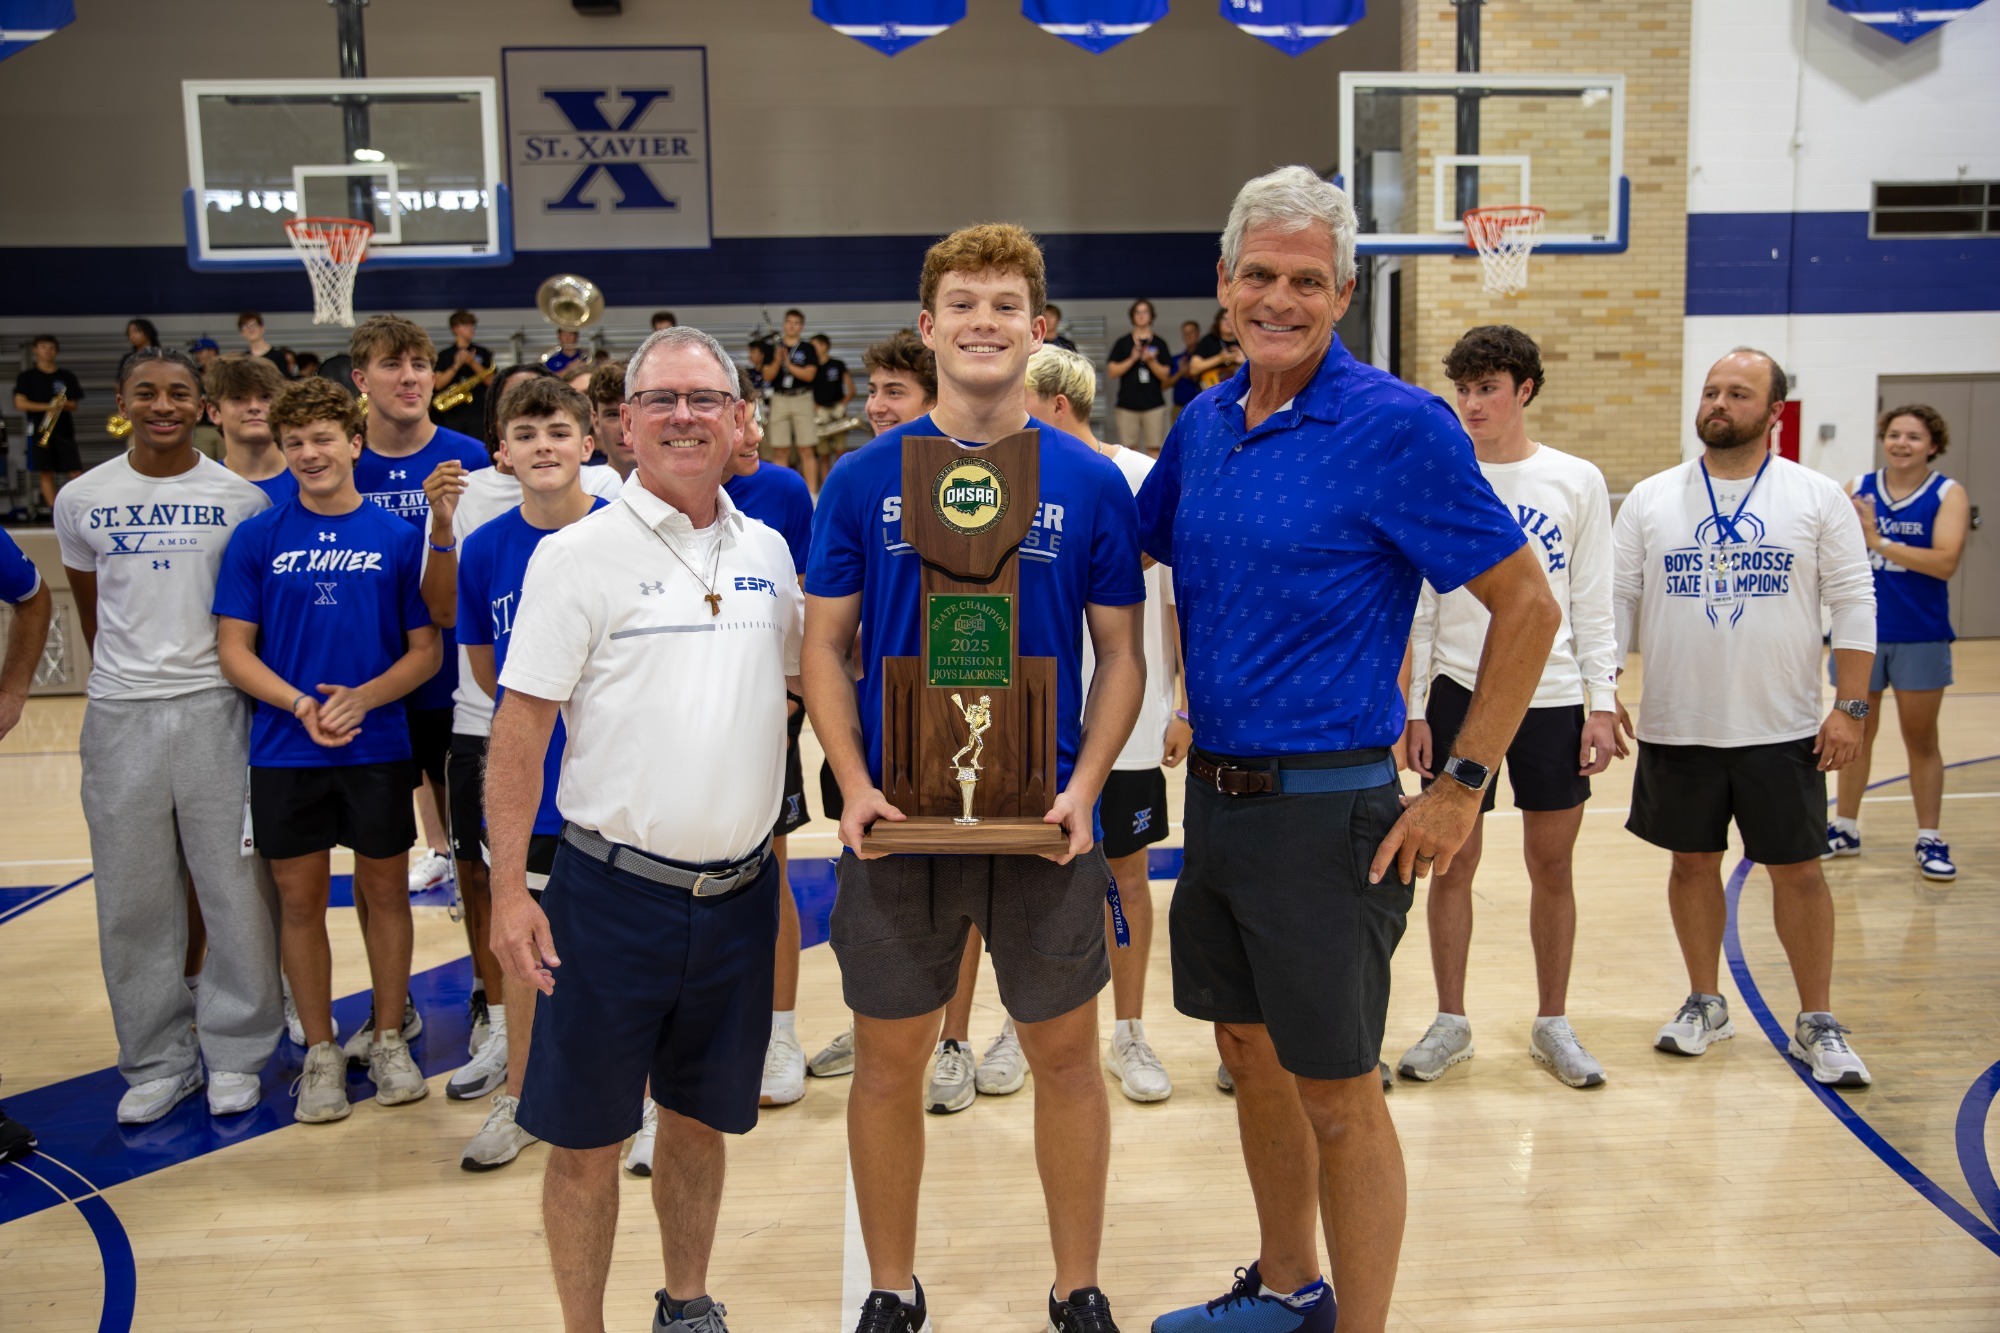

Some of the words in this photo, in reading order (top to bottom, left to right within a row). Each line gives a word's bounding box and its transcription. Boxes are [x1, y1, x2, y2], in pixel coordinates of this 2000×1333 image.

[946, 487, 995, 504] OHSAA
[90, 506, 120, 529] ST.
[126, 504, 228, 527] XAVIER
[110, 536, 131, 551] X
[1517, 504, 1566, 573] VIER
[272, 550, 307, 574] ST.
[306, 549, 382, 573] XAVIER
[1664, 553, 1703, 572] BOYS
[314, 582, 338, 605] X
[734, 577, 777, 597] ESPX
[1666, 575, 1702, 594] STATE
[931, 604, 959, 631] STATE
[959, 601, 1008, 632] CHAMPION
[950, 639, 990, 652] 2025
[937, 656, 994, 666] DIVISION
[997, 657, 1002, 666] I
[933, 669, 957, 679] BOYS
[959, 669, 1006, 680] LACROSSE
[1111, 894, 1124, 935] XAVIER
